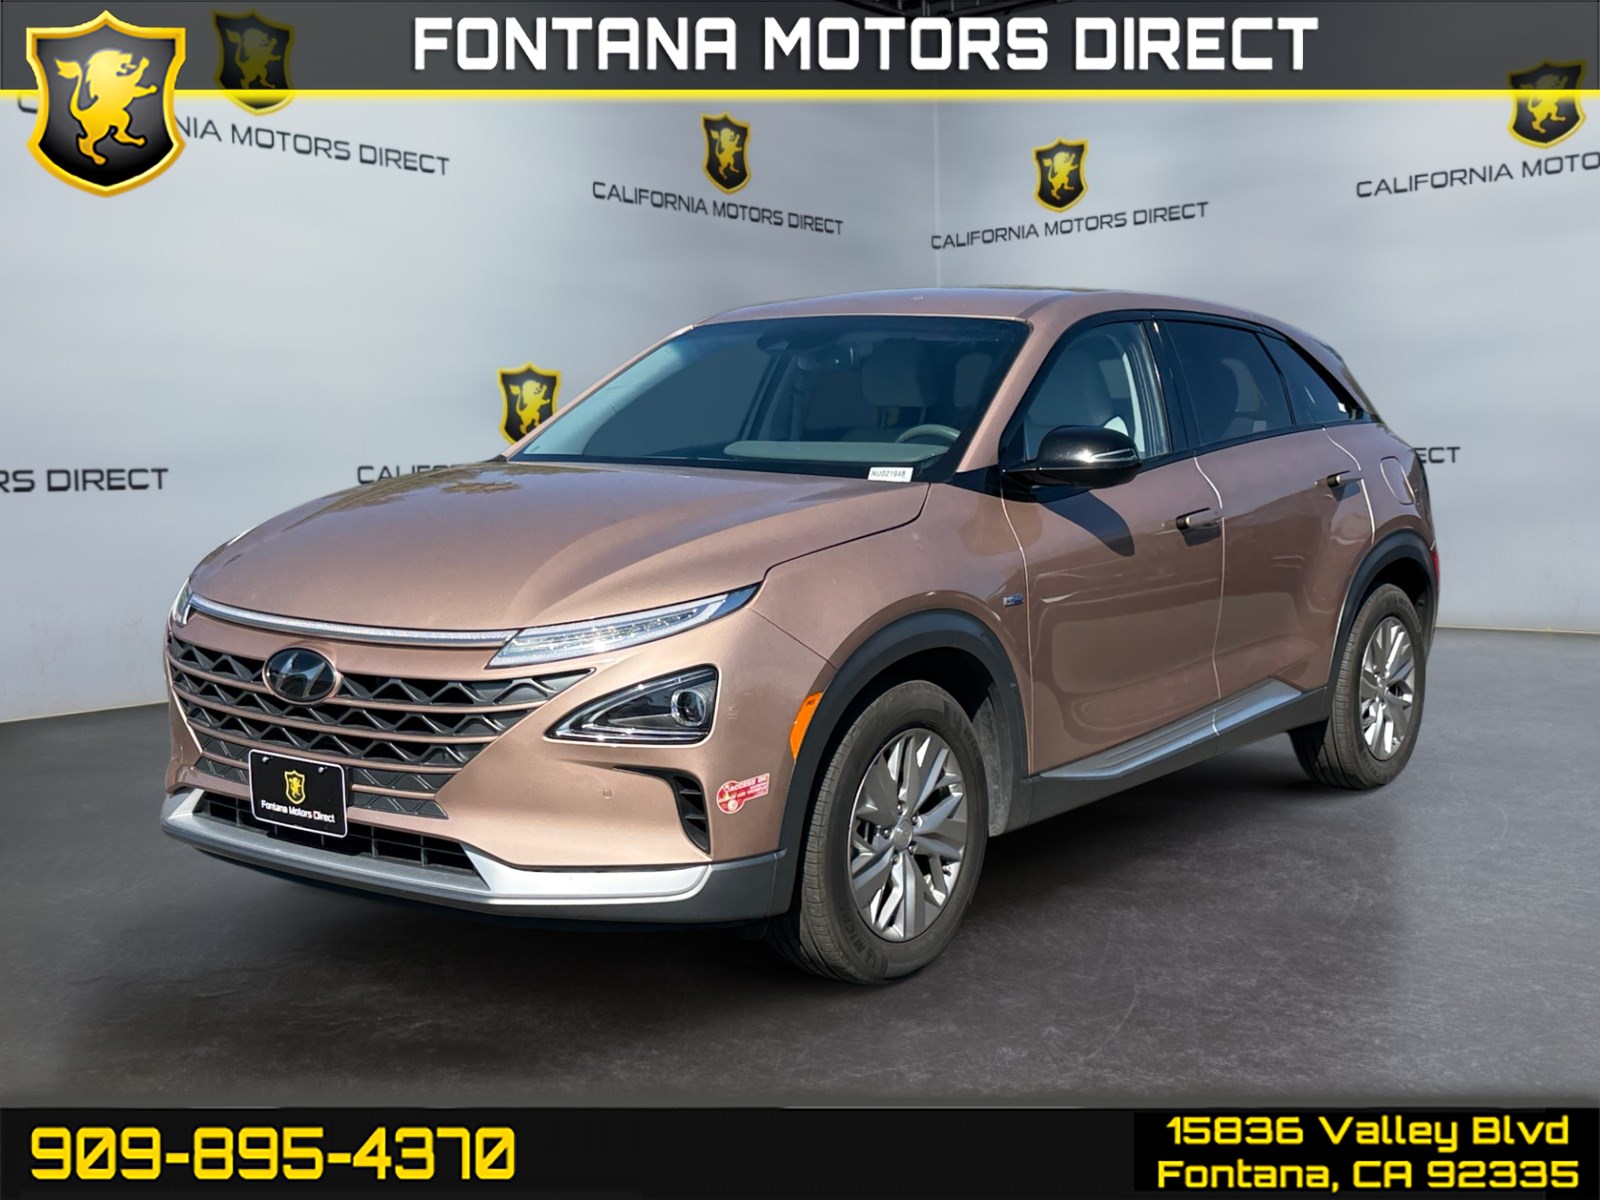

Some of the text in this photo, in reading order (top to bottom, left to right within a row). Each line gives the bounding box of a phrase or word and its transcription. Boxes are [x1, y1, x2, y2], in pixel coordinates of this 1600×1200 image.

[231, 123, 450, 176] MOTORS DIRECT
[1356, 163, 1514, 198] CALIFORNIA
[592, 181, 844, 236] CALIFORNIA MOTORS DIRECT
[931, 200, 1209, 250] CALIFORNIA MOTORS DIRECT
[46, 467, 169, 493] DIRECT
[261, 800, 335, 823] Fontana Motors Direct
